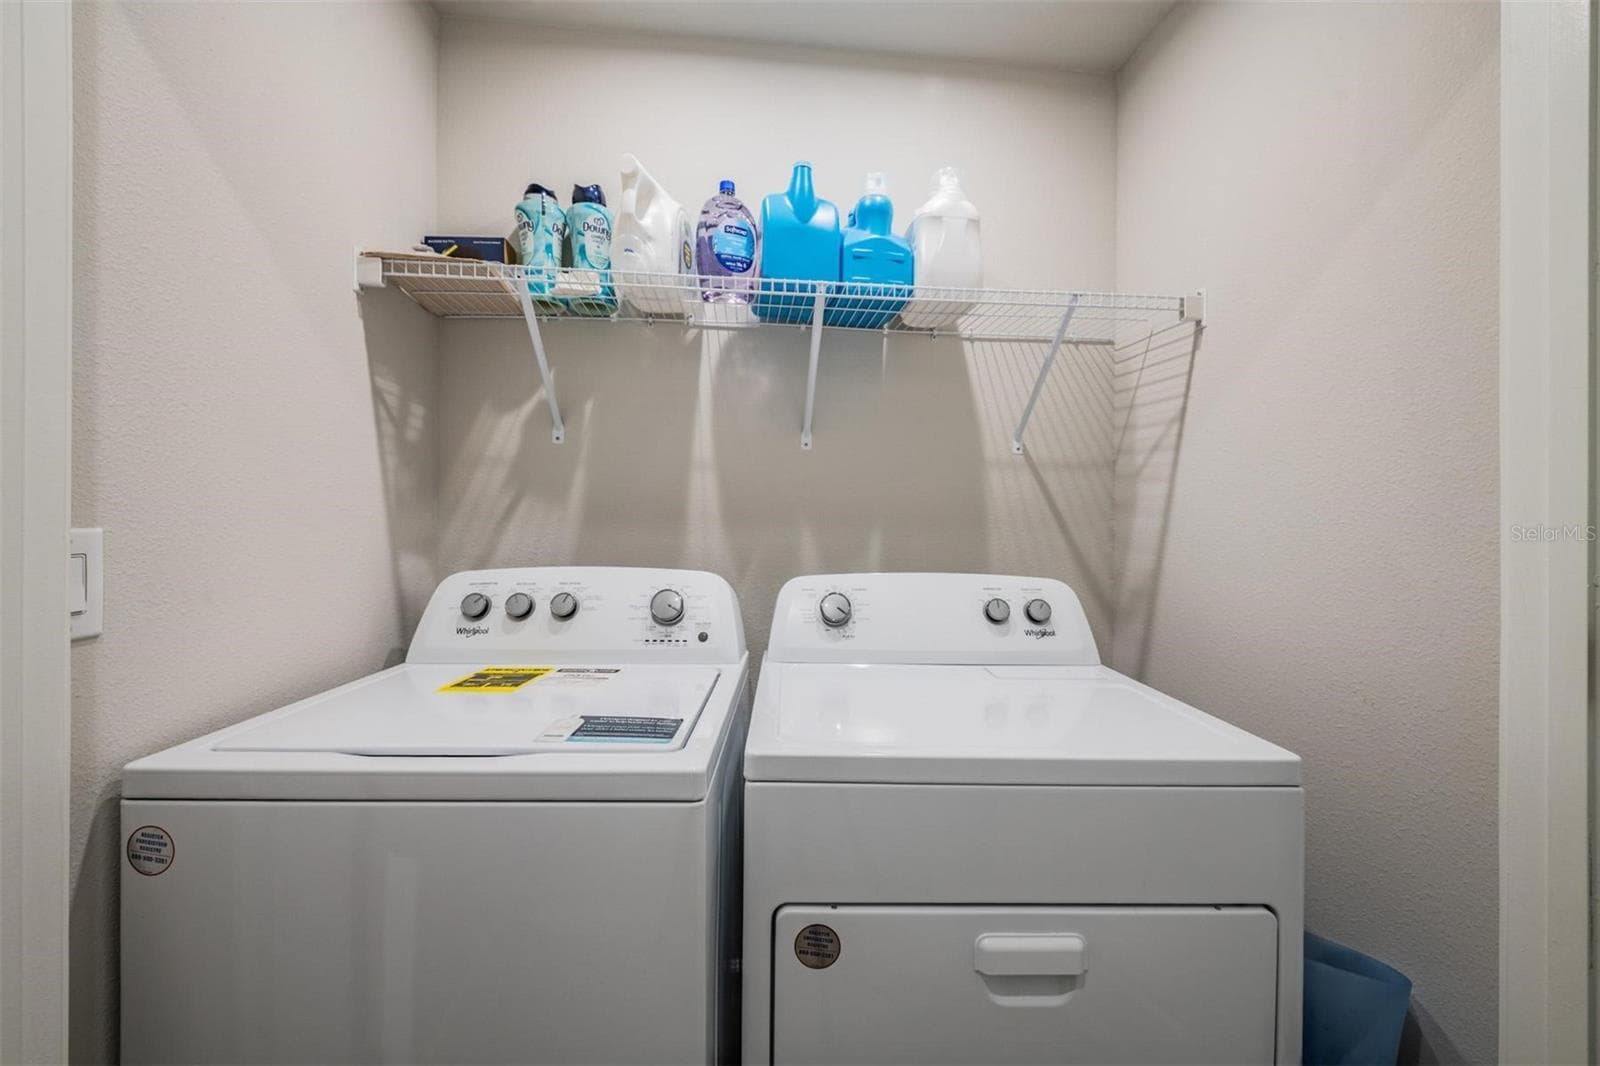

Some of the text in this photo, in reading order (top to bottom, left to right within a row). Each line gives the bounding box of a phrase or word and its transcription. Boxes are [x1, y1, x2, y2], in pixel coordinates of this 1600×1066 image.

[582, 221, 612, 241] Downy
[456, 626, 490, 638] Whirlpool
[1024, 629, 1056, 640] Whirlpool
